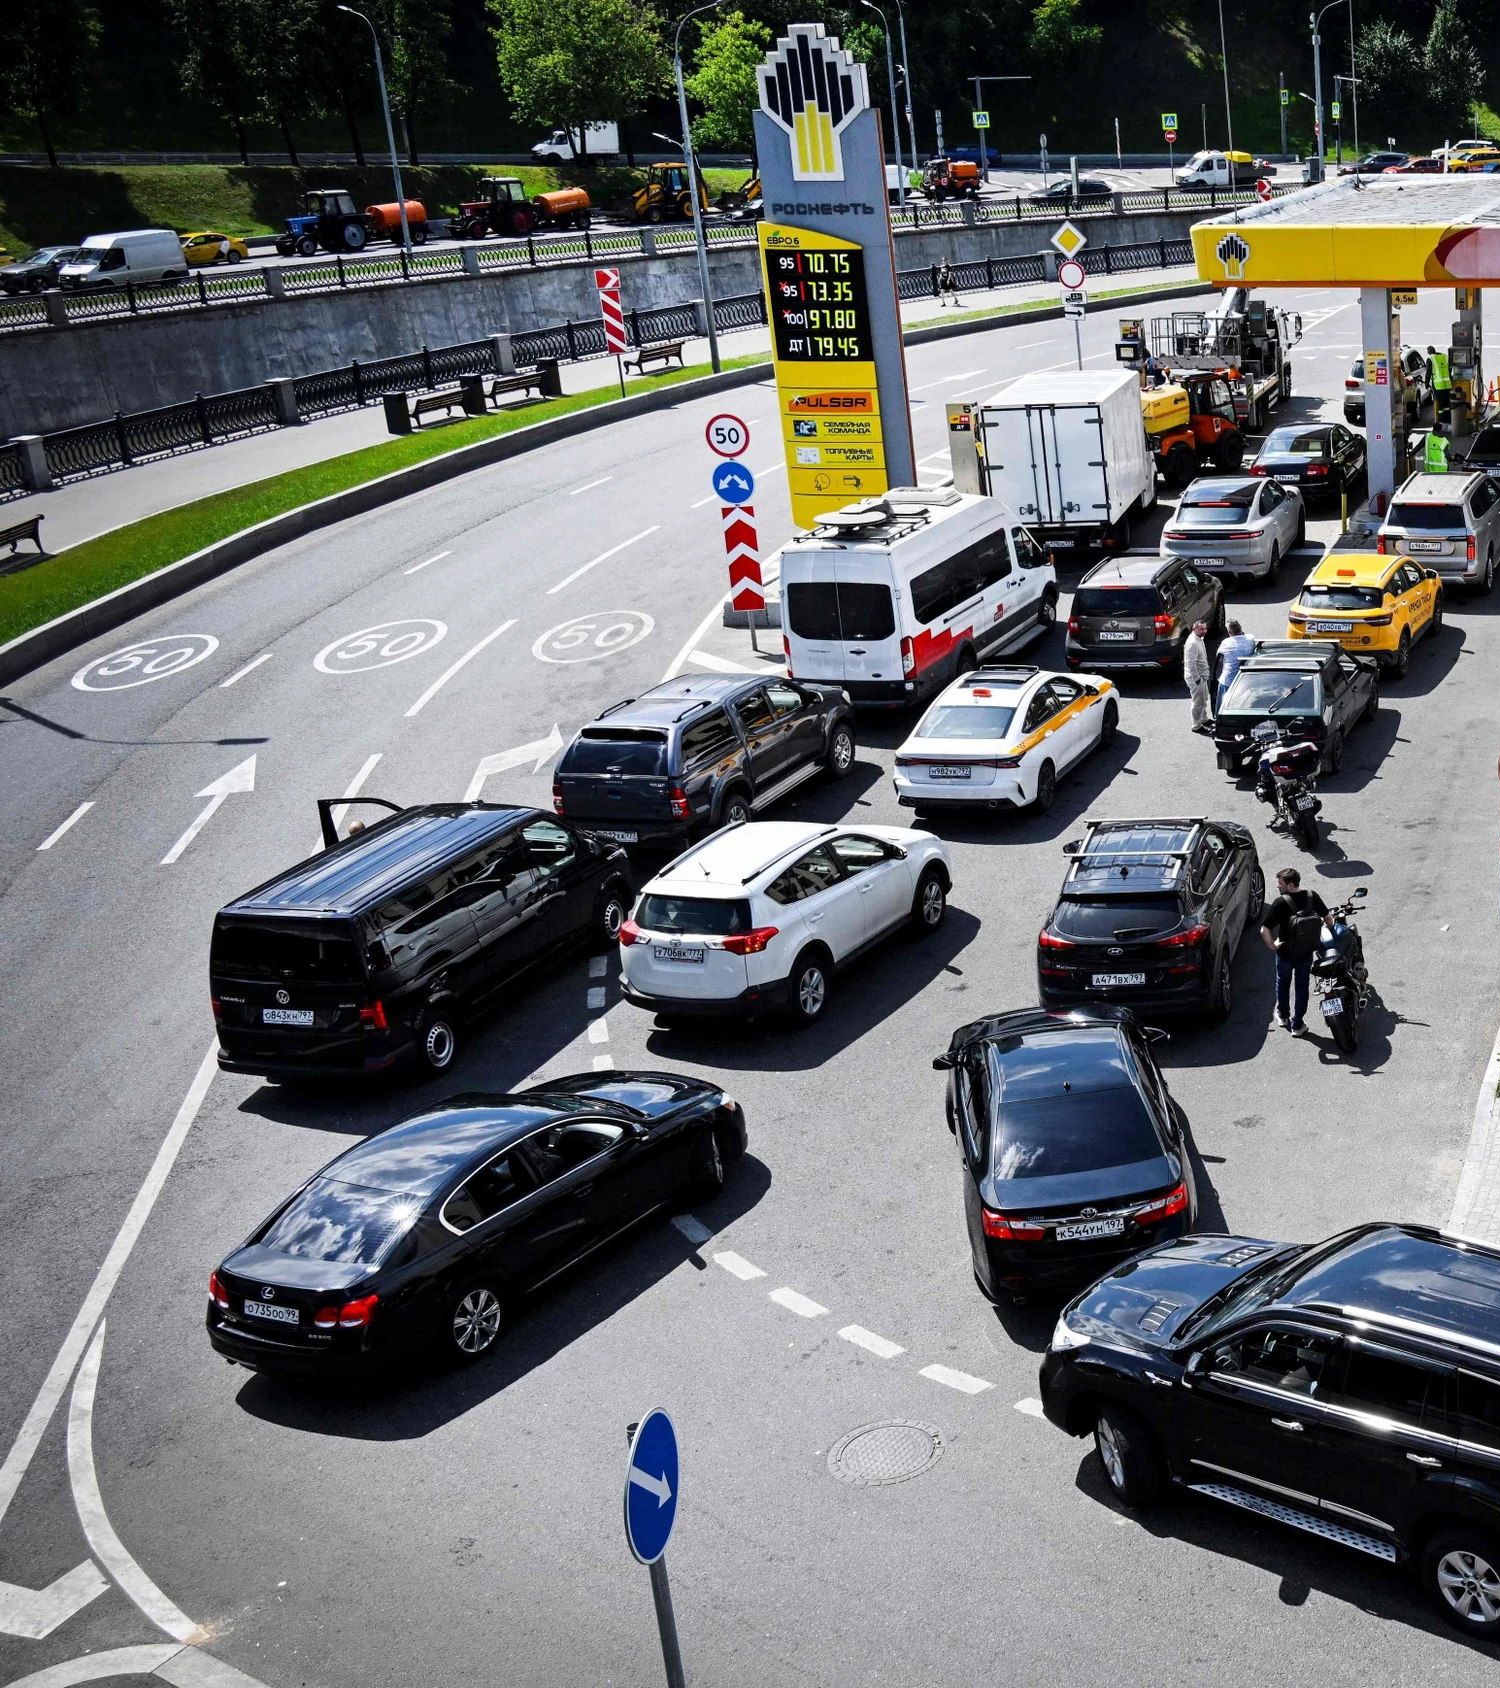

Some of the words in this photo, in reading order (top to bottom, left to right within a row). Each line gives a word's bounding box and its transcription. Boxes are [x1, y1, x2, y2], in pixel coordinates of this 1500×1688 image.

[772, 203, 875, 215] РОСНЕФТЬ
[767, 237, 793, 245] ЕВРО
[779, 257, 794, 269] 95
[804, 253, 850, 273] 70.75
[783, 285, 797, 297] 95
[807, 281, 853, 301] 73.35
[786, 313, 803, 325] 100
[809, 310, 856, 329] 97.80
[789, 339, 803, 352] ДТ
[813, 337, 859, 357] 79.45
[963, 405, 971, 414] 5
[715, 427, 740, 444] 50
[337, 631, 427, 657] 50
[552, 623, 639, 649] 50
[98, 648, 196, 676] 50
